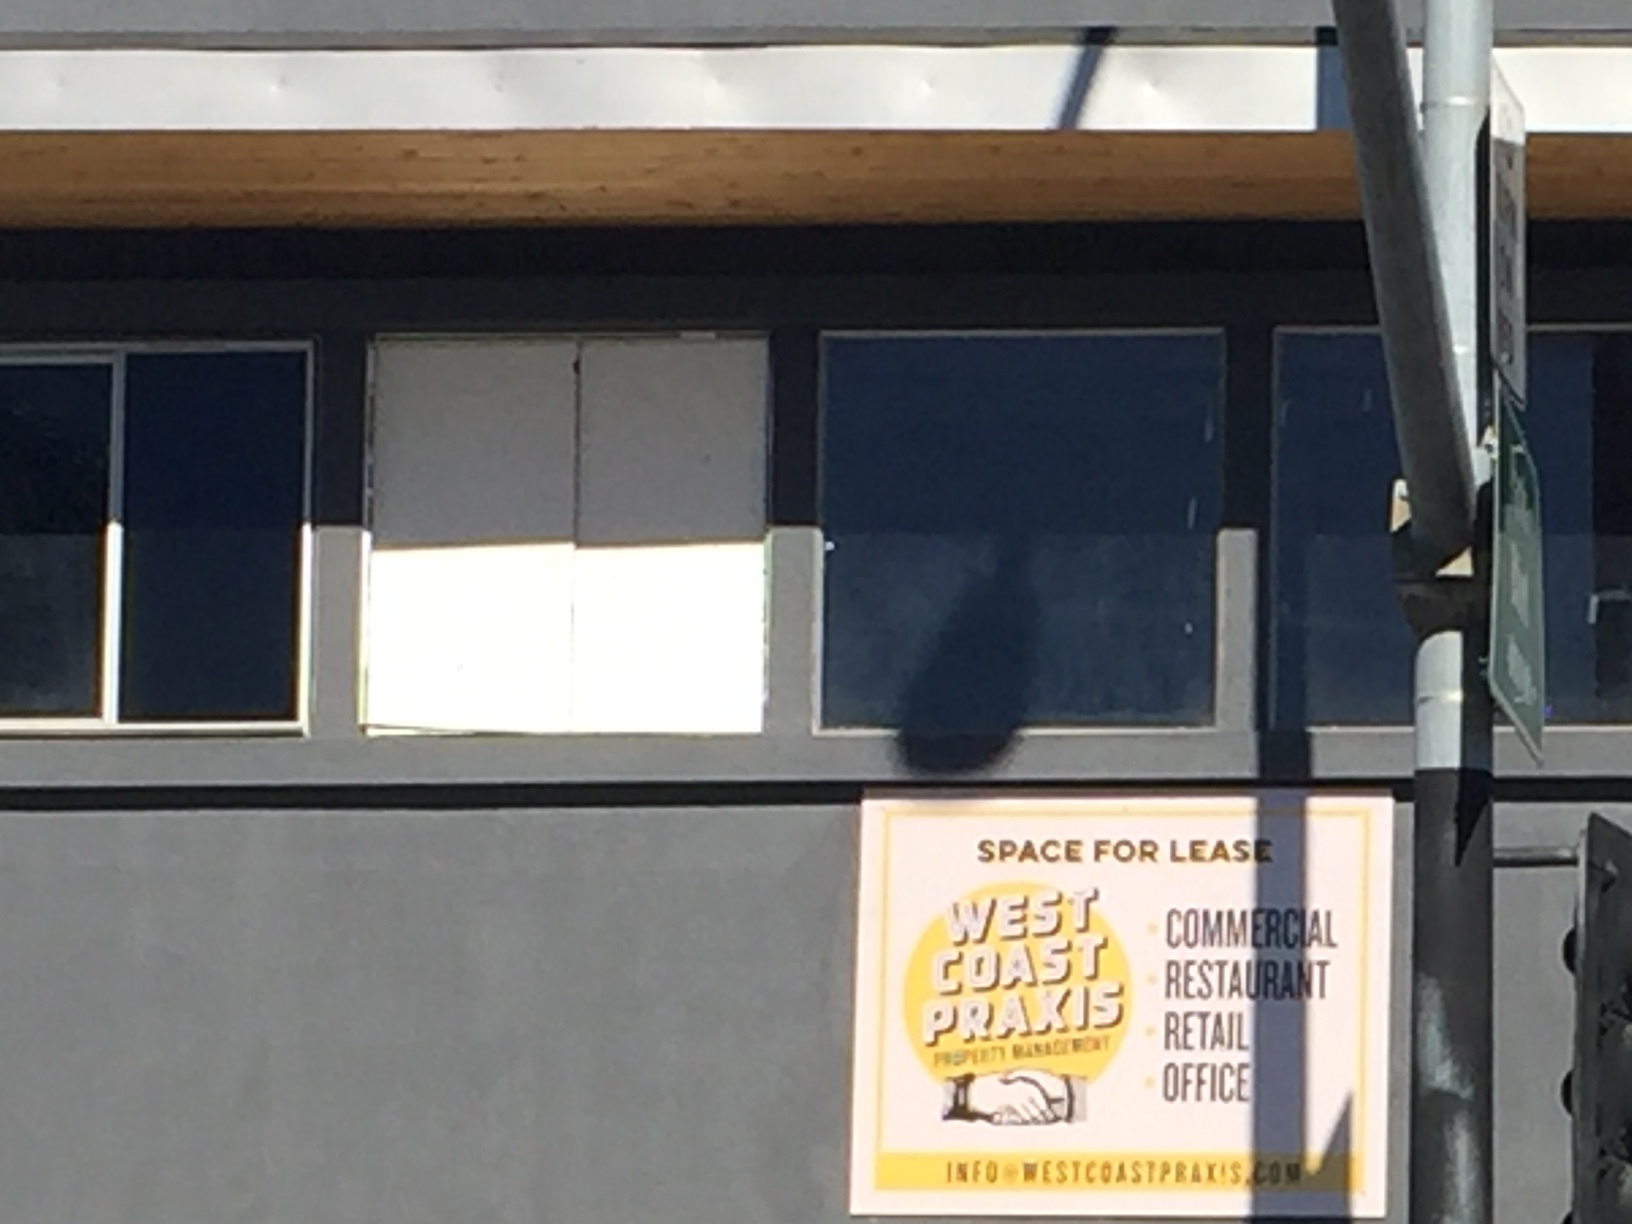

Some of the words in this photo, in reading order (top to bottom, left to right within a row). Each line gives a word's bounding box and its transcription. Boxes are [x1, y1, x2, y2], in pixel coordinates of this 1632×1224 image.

[977, 839, 1082, 863] SPACE
[1093, 839, 1158, 863] FOR
[1170, 839, 1275, 864] LEASE
[943, 887, 1100, 946] WEST
[1165, 908, 1338, 949] COMMERCIAL
[930, 934, 1109, 996] COAST
[1164, 959, 1331, 1001] RESTAURANT
[922, 982, 1126, 1047] PRAXIS
[1163, 1011, 1250, 1051] RETAIL
[933, 1044, 1007, 1068] PROPERTY
[1011, 1034, 1111, 1061] MANAGEMENT
[1162, 1062, 1251, 1103] OFFICE
